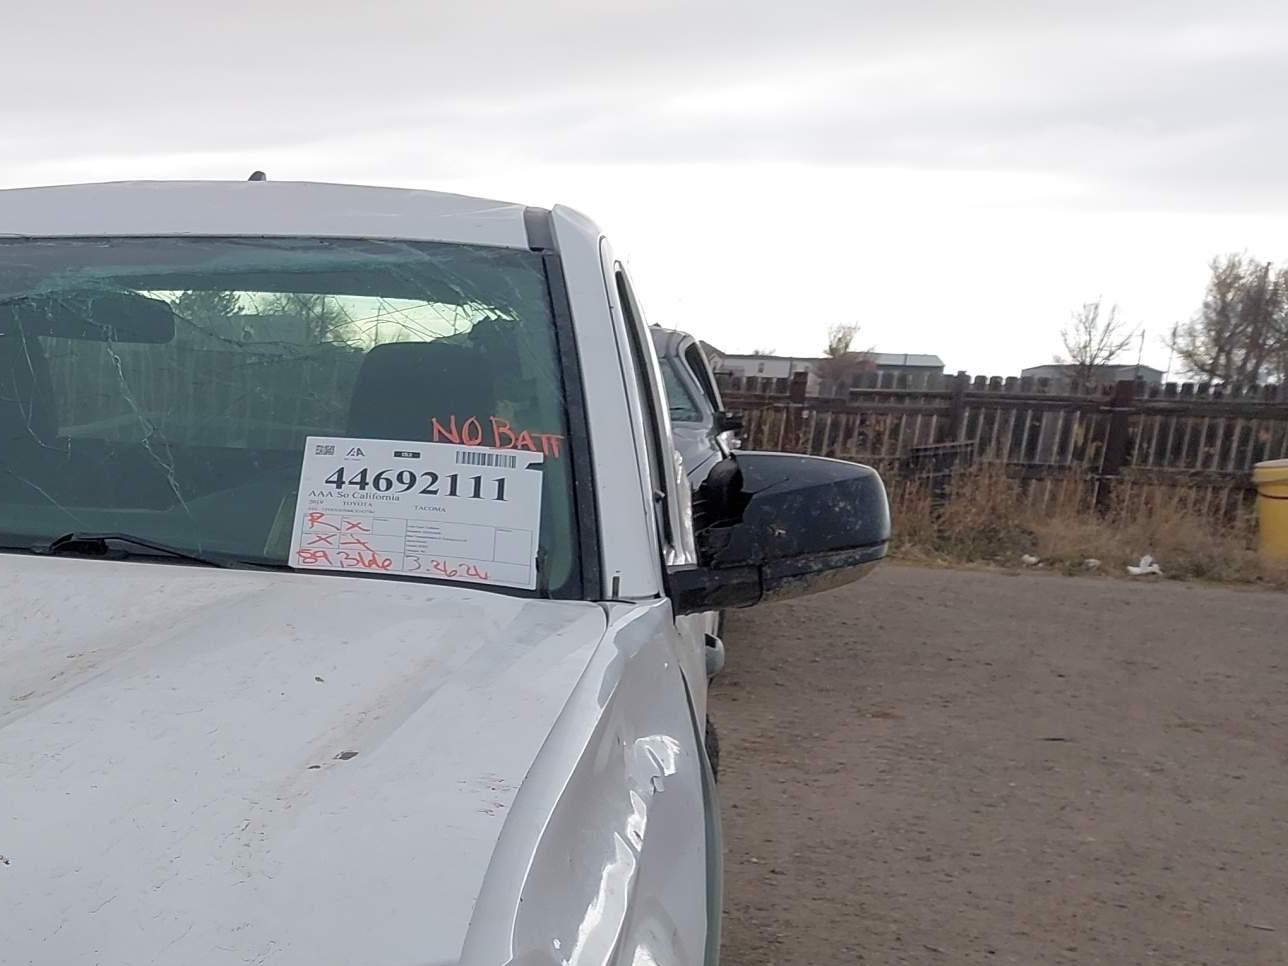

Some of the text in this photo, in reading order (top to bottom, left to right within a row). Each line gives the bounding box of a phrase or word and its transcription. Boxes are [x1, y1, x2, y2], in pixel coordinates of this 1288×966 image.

[431, 415, 565, 458] NO BATT
[308, 489, 400, 502] AAA So California
[324, 466, 509, 501] 44692111
[414, 504, 446, 513] TACOMA
